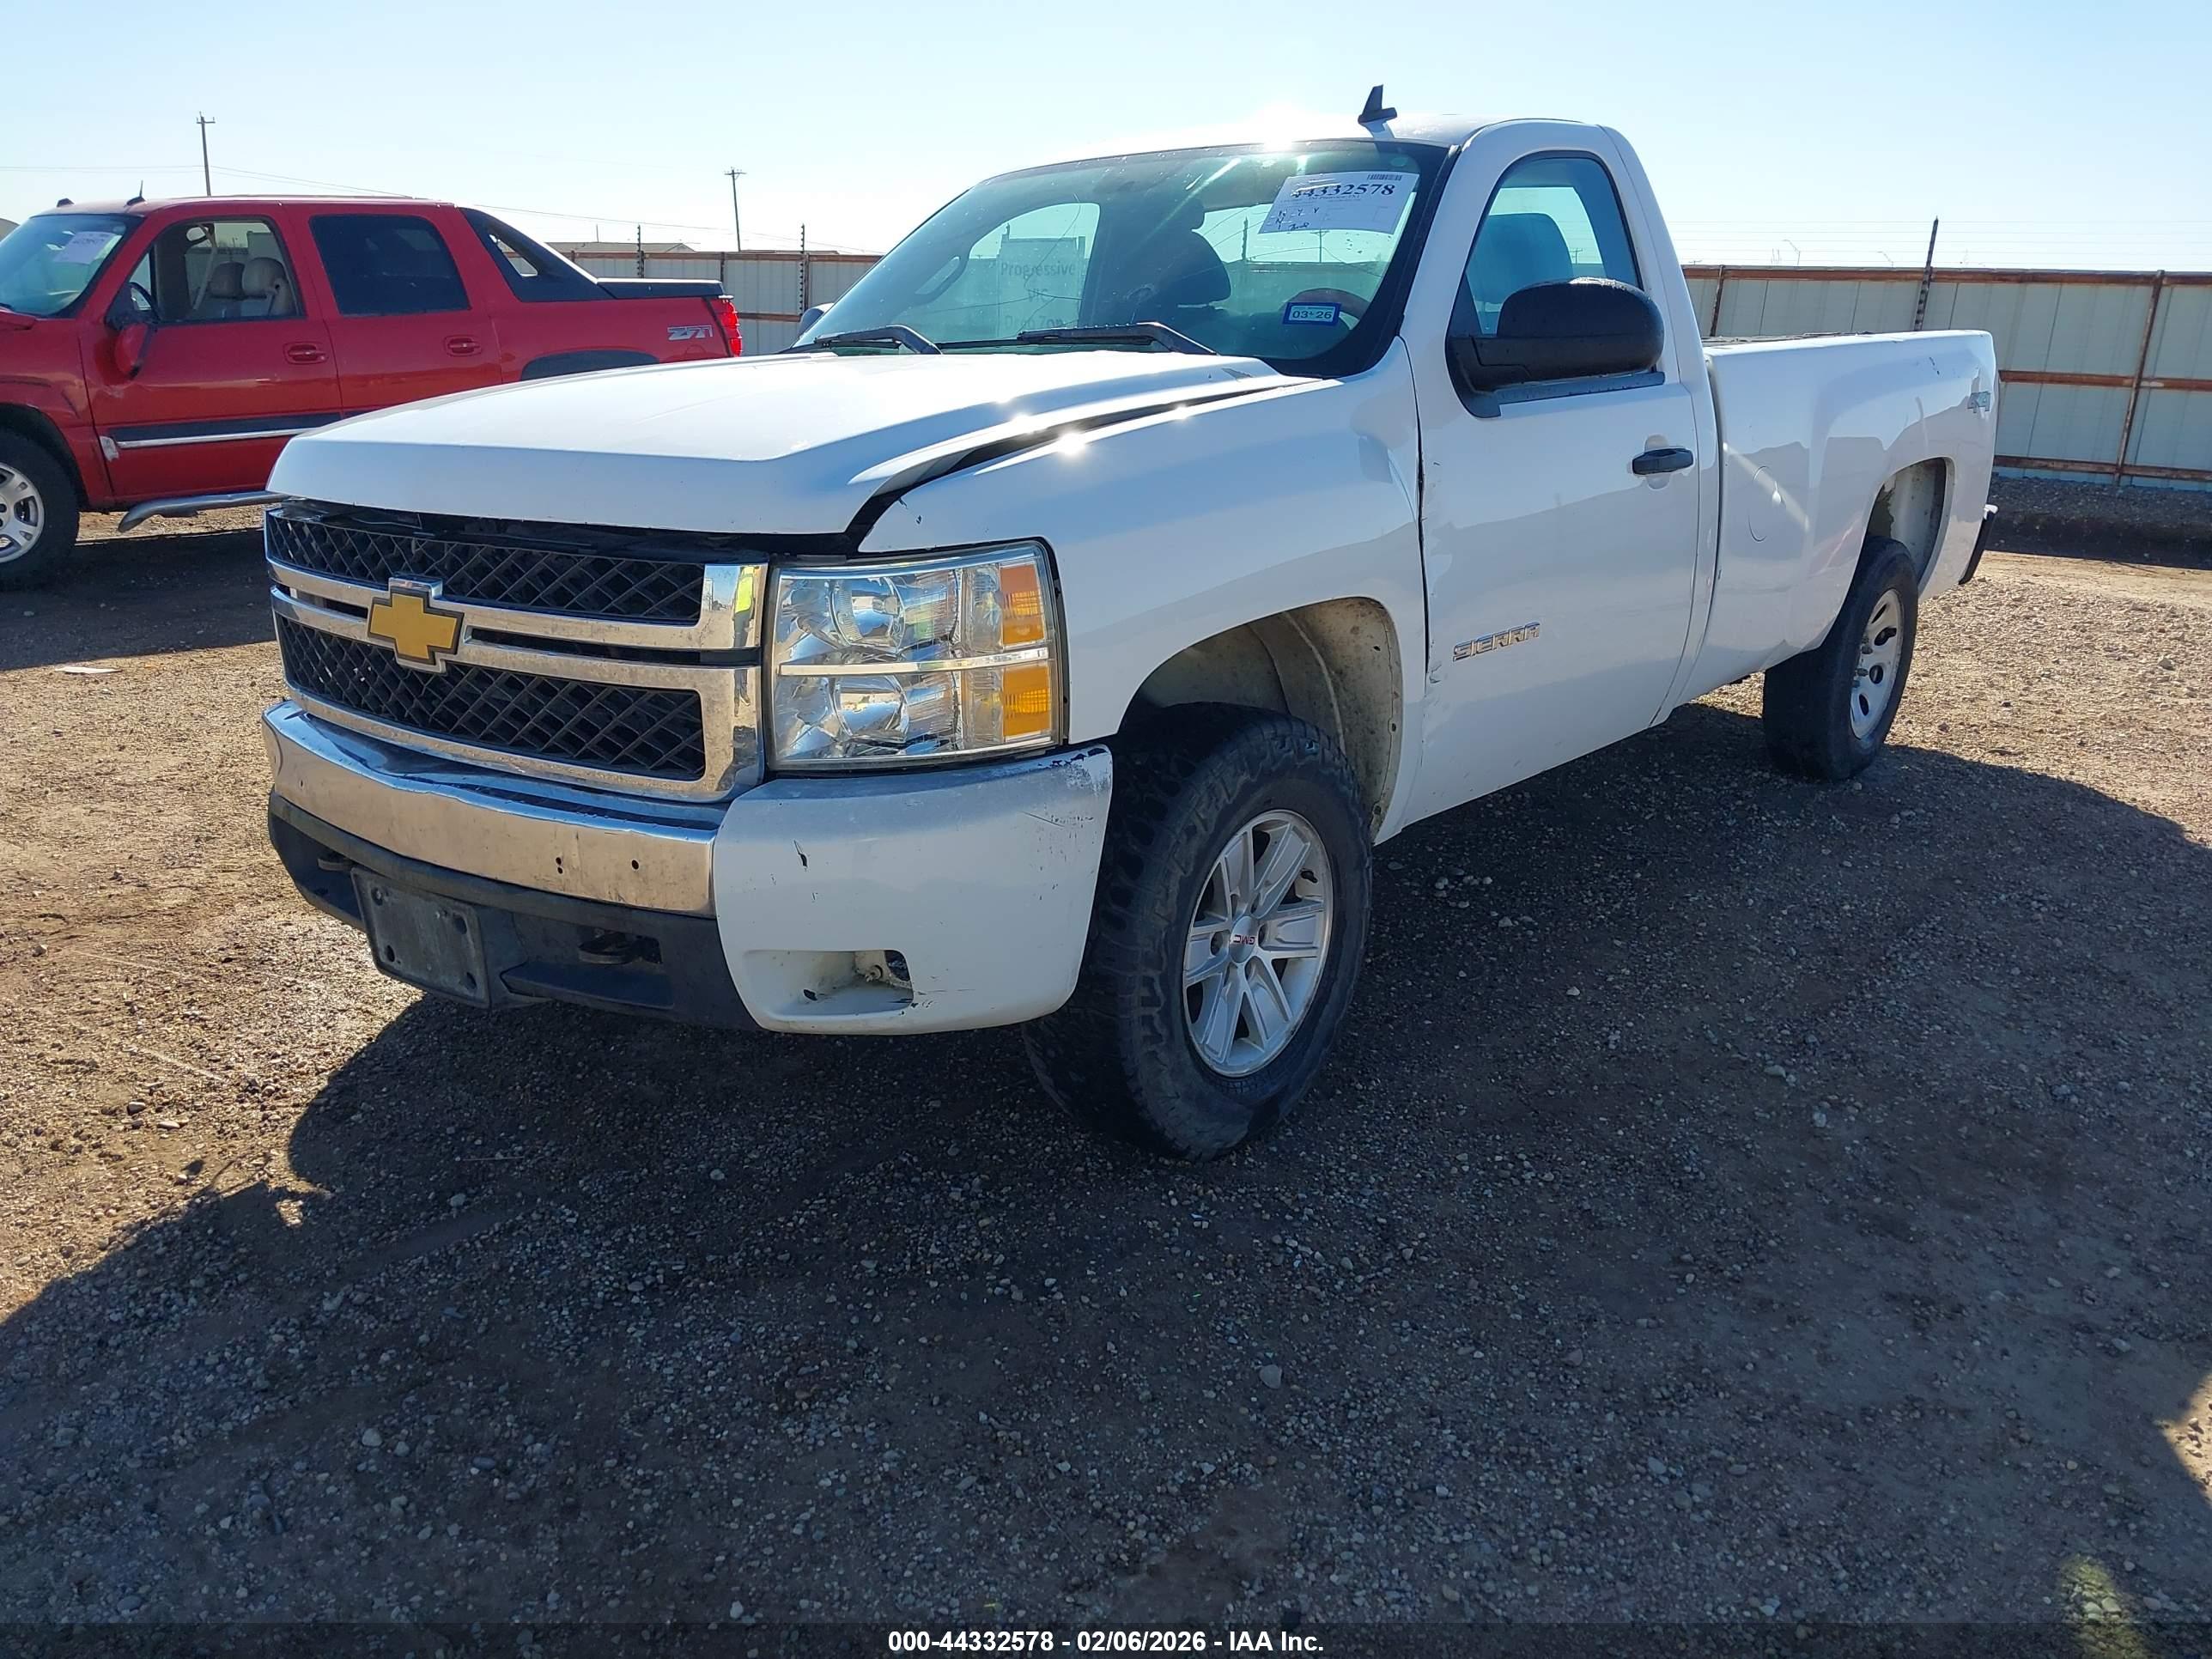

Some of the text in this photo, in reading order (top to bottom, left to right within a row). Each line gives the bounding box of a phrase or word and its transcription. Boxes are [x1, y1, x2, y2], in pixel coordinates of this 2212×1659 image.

[1000, 261, 1076, 280] Progressive
[1292, 310, 1308, 319] 03
[667, 325, 714, 341] Z71
[1452, 622, 1540, 662] SIERRA
[1233, 934, 1255, 945] GMC
